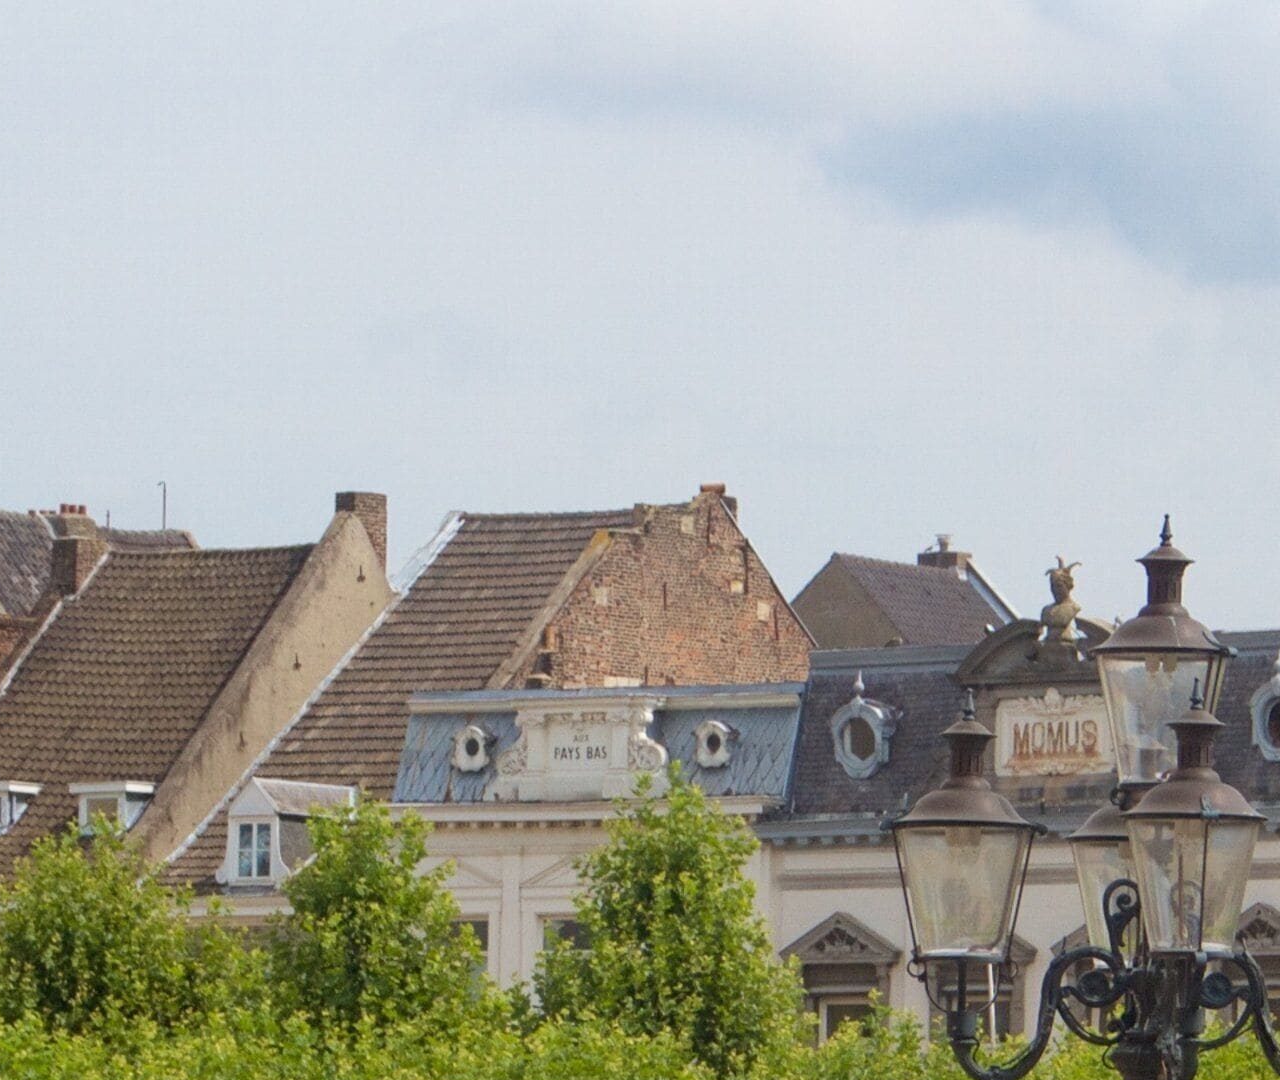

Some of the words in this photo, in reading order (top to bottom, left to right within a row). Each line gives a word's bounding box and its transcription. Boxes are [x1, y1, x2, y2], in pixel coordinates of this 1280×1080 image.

[1013, 720, 1098, 757] MOMUS
[553, 746, 581, 760] PAYS
[586, 745, 608, 760] BAS
